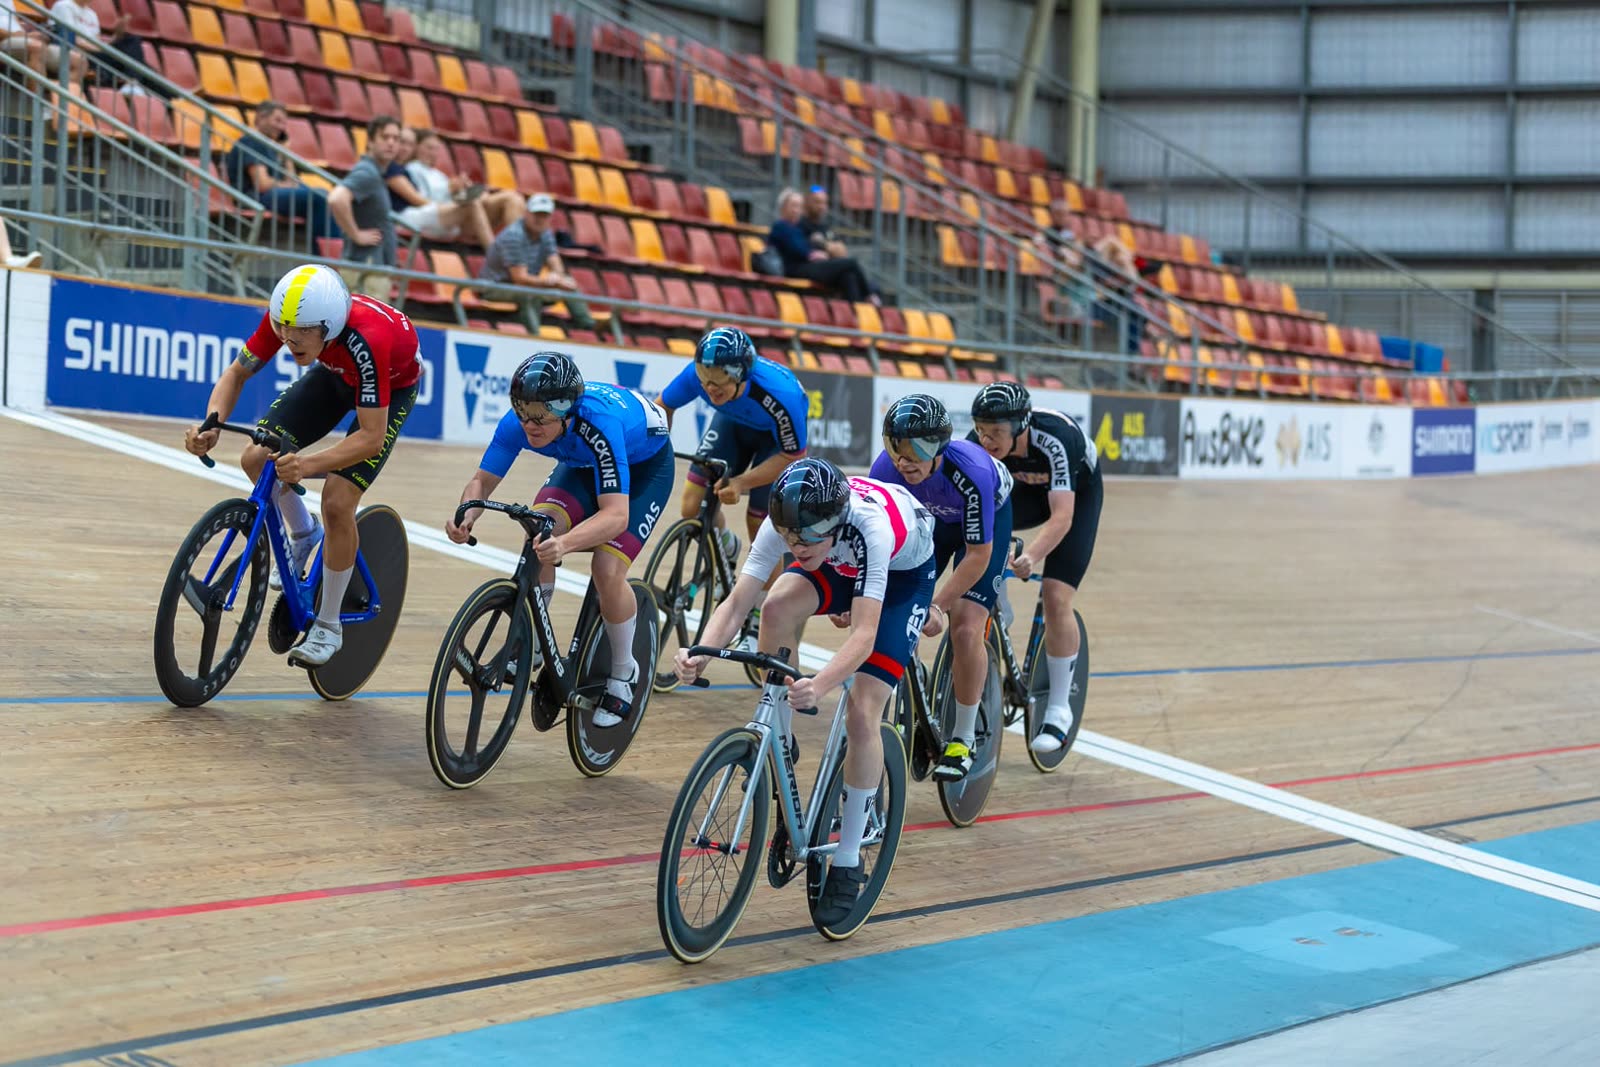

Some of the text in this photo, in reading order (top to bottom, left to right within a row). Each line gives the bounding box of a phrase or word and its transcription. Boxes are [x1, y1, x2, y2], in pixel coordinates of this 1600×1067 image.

[762, 395, 797, 452] BLACKLINE
[1122, 412, 1145, 436] AUS
[1304, 421, 1332, 462] AIS
[1415, 425, 1473, 456] SHIMANO
[579, 422, 617, 489] BLACKLINE
[1036, 434, 1068, 487] BLACKLINE
[638, 501, 661, 540] QAS
[952, 470, 981, 541] BLACKLINE
[180, 510, 254, 583] PRINCETO
[779, 735, 807, 830] MERIDA
